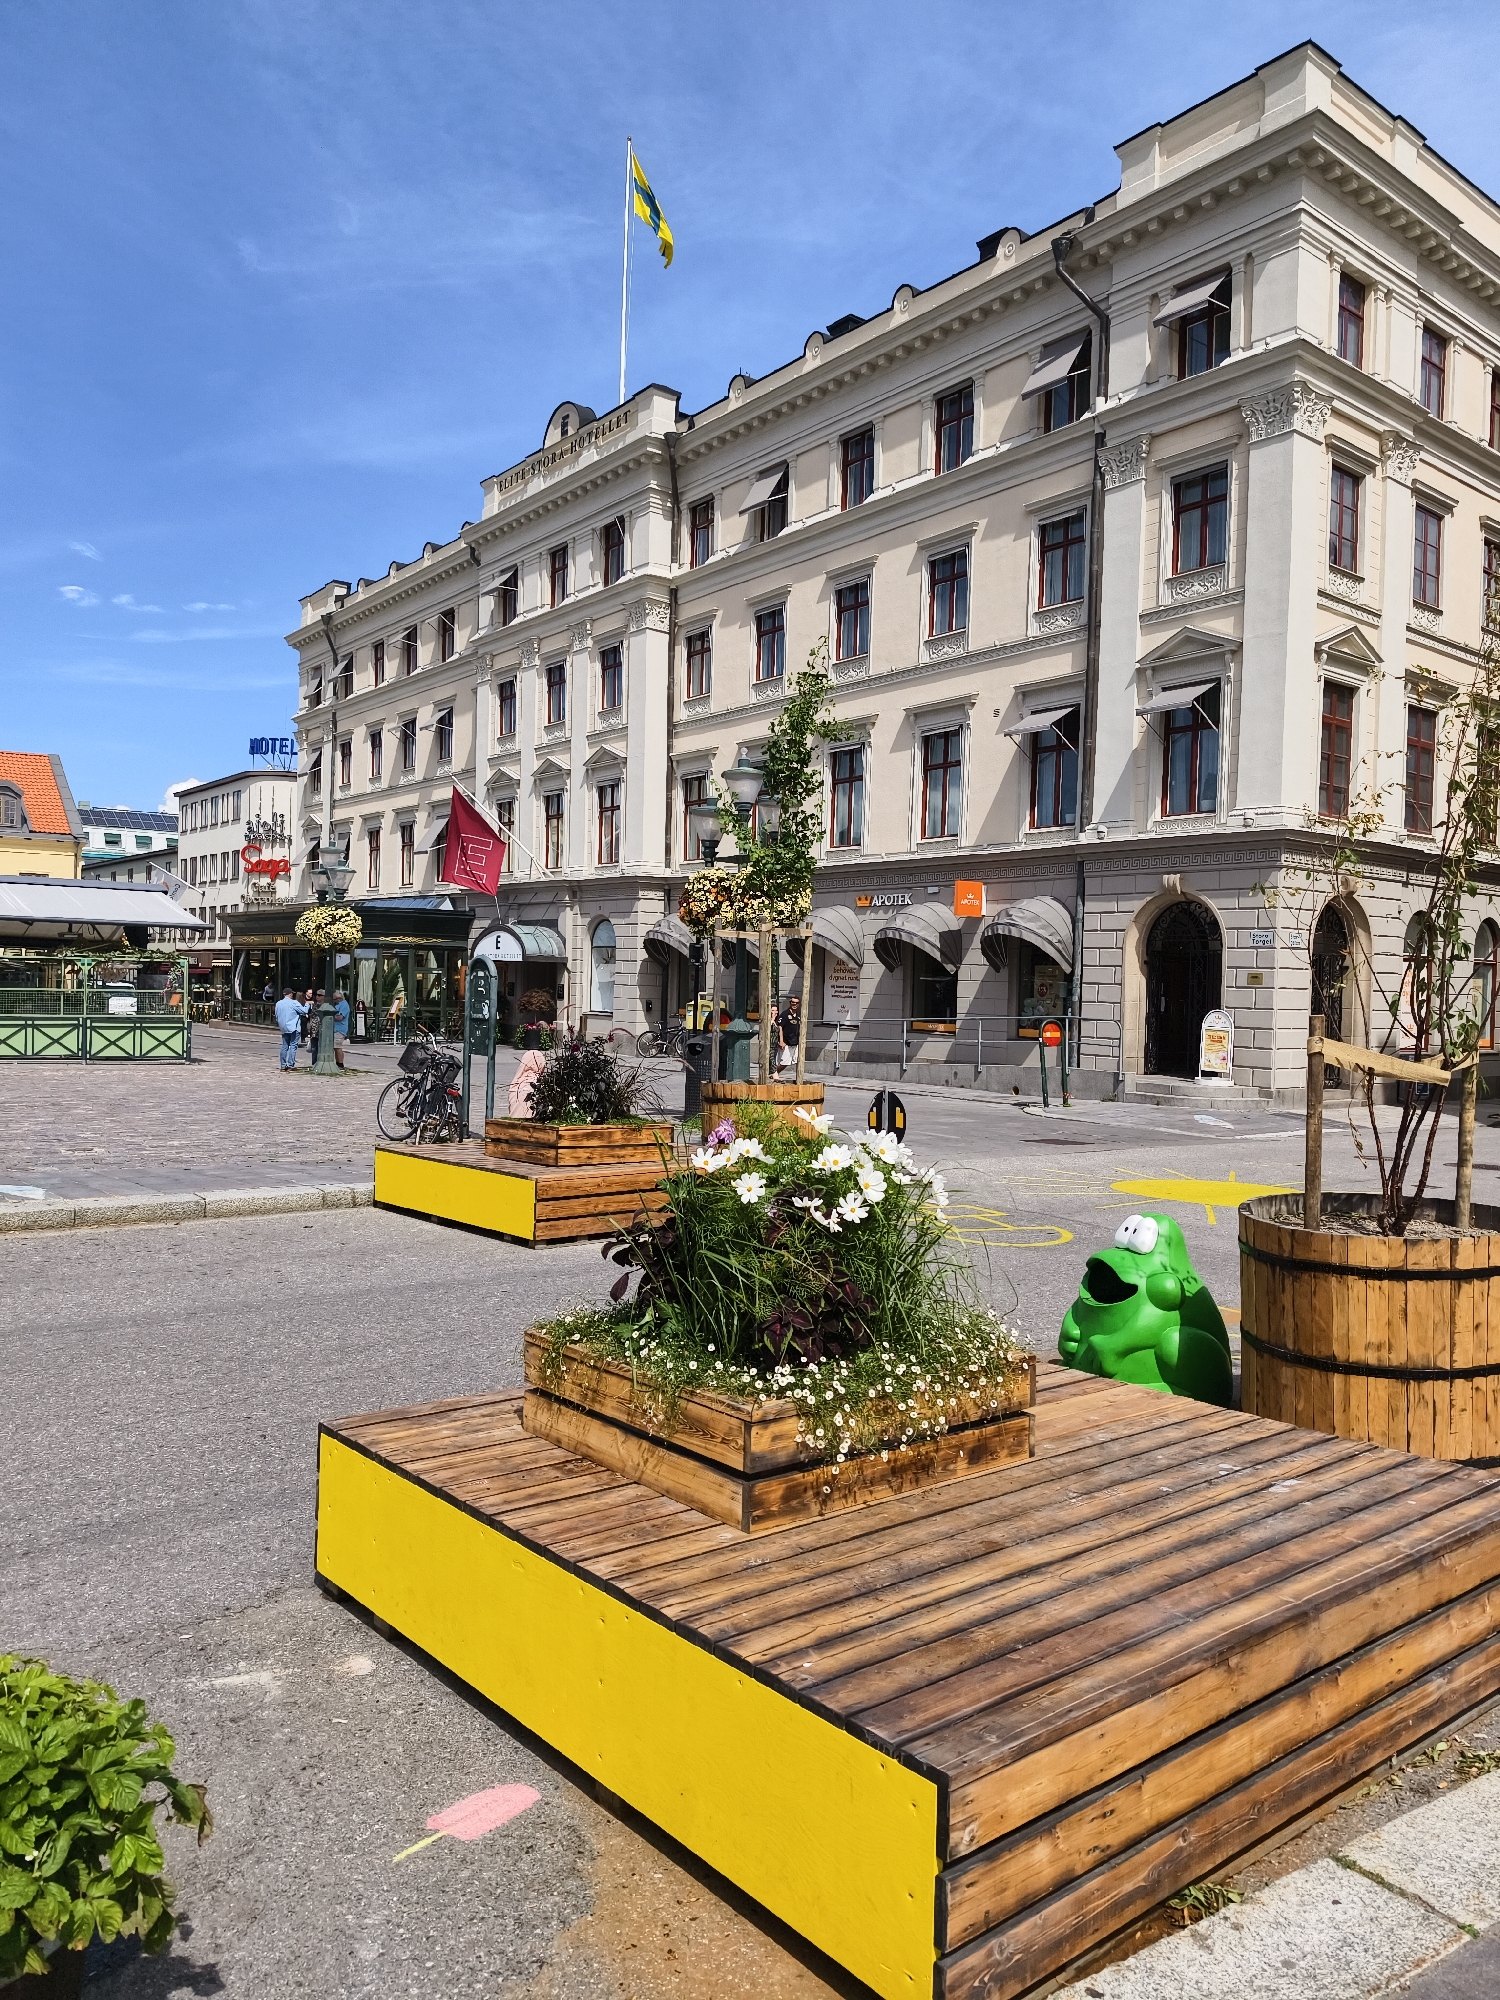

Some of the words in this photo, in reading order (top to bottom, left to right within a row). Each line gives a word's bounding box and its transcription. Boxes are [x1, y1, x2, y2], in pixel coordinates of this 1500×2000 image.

[498, 468, 527, 492] ELITE
[530, 447, 565, 476] STORA
[569, 409, 631, 454] HOTELLET
[248, 737, 298, 756] HOTEL
[240, 844, 292, 880] Saga
[871, 893, 913, 907] APOTEK
[960, 899, 980, 907] APOTEK
[495, 935, 502, 949] E
